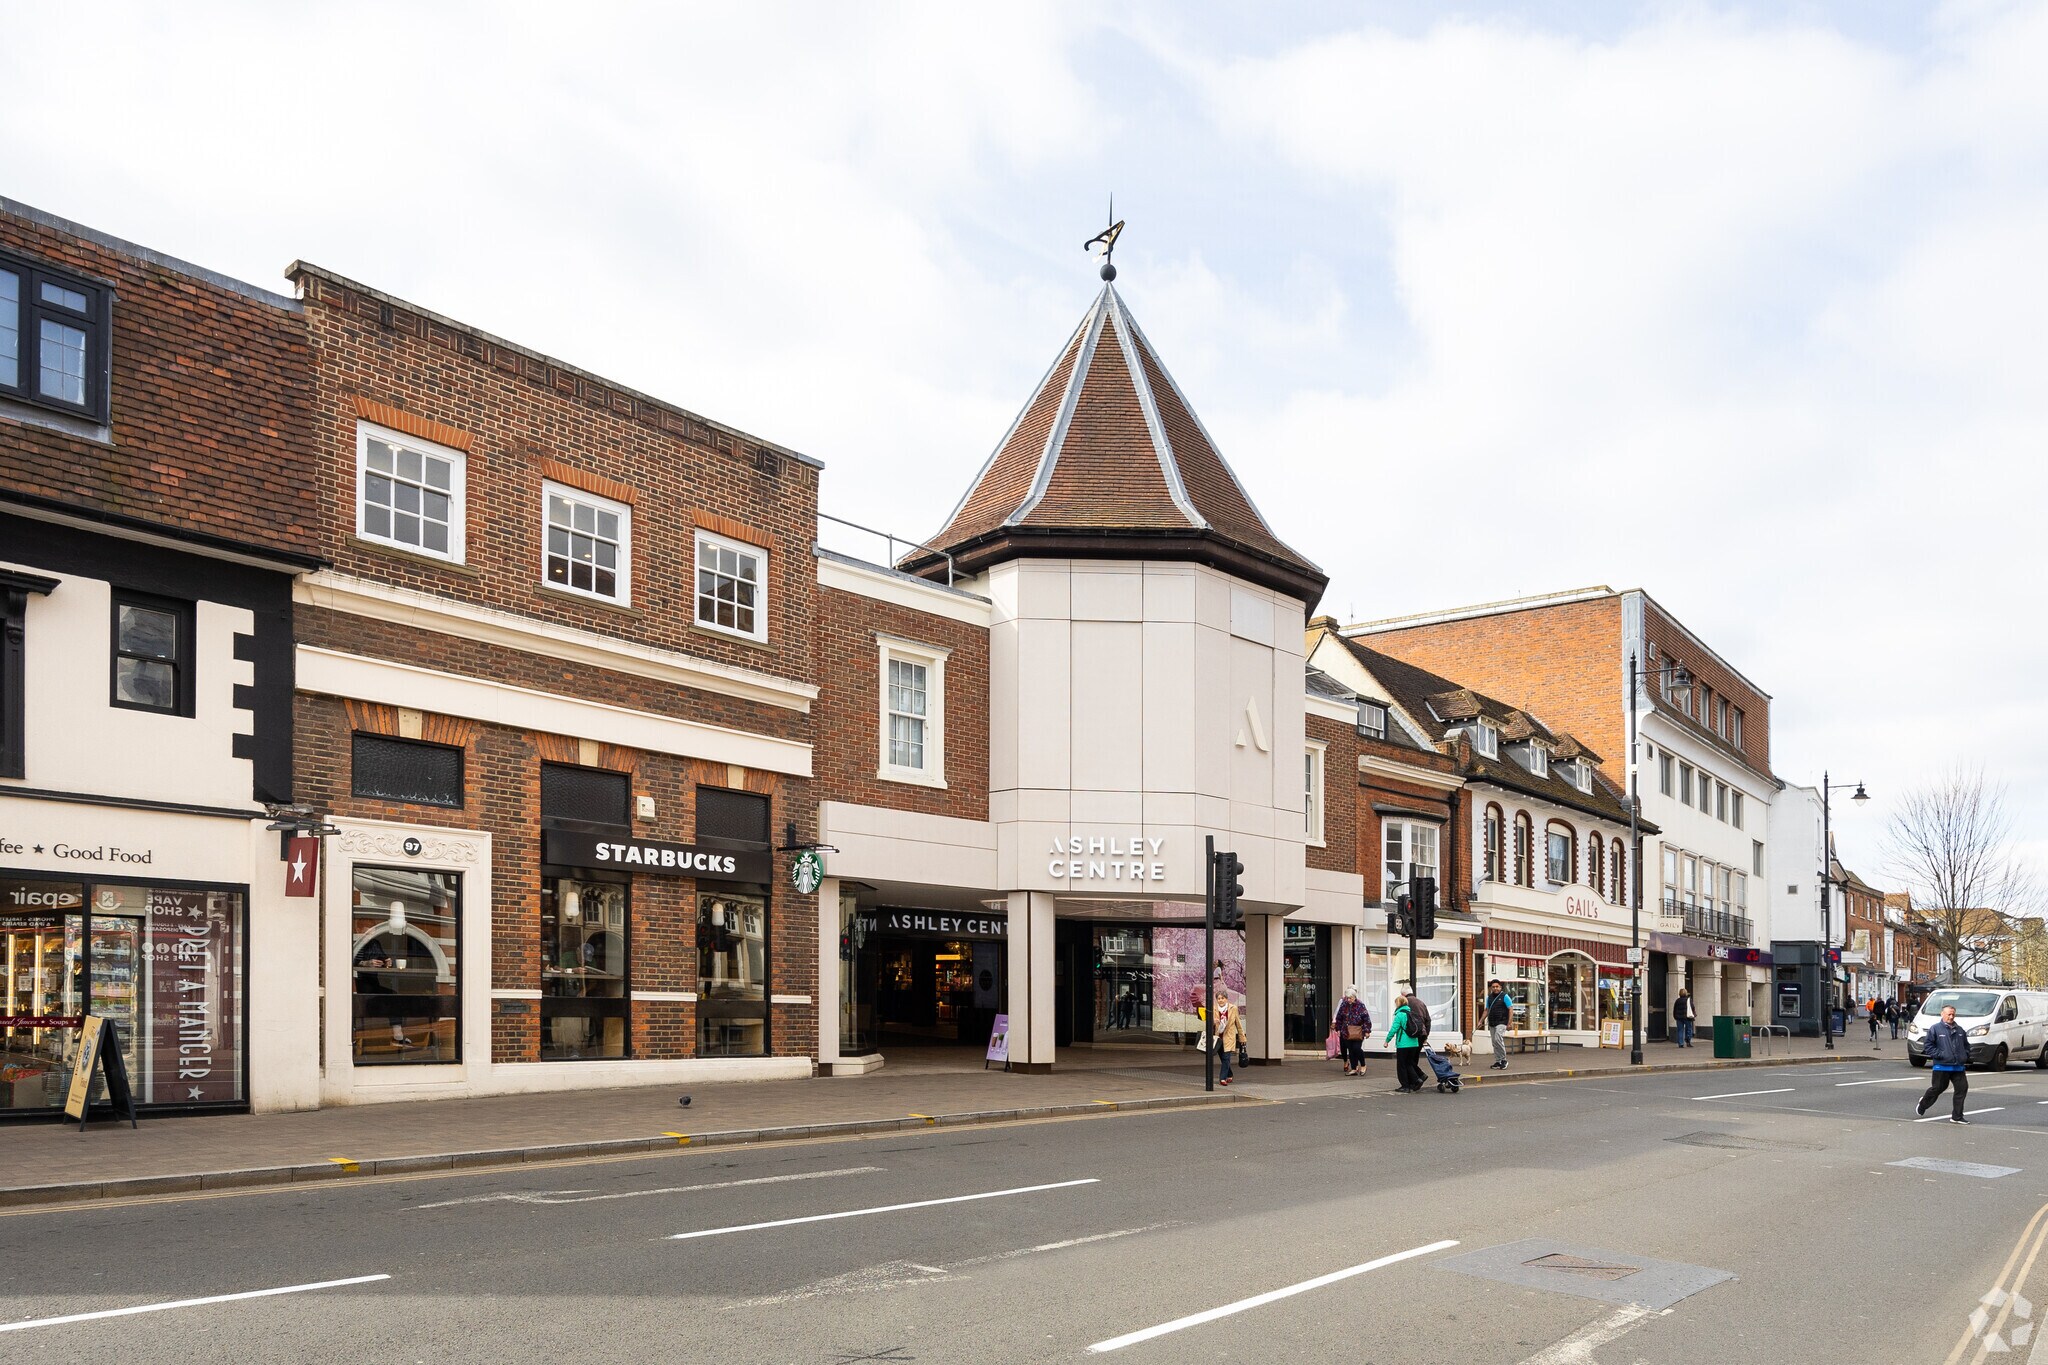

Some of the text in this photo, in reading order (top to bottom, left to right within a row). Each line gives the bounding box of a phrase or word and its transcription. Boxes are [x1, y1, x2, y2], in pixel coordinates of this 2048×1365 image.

[53, 843, 103, 861] Good
[109, 847, 152, 864] Food
[405, 842, 420, 852] 97
[1049, 836, 1164, 856] ASHLEY
[595, 842, 736, 873] STARBUCKS
[1048, 860, 1165, 880] CENTRE
[1566, 896, 1599, 919] GAIL's
[888, 914, 963, 932] ASHLEY
[179, 926, 211, 972] PRET
[179, 1001, 212, 1080] MANGER
